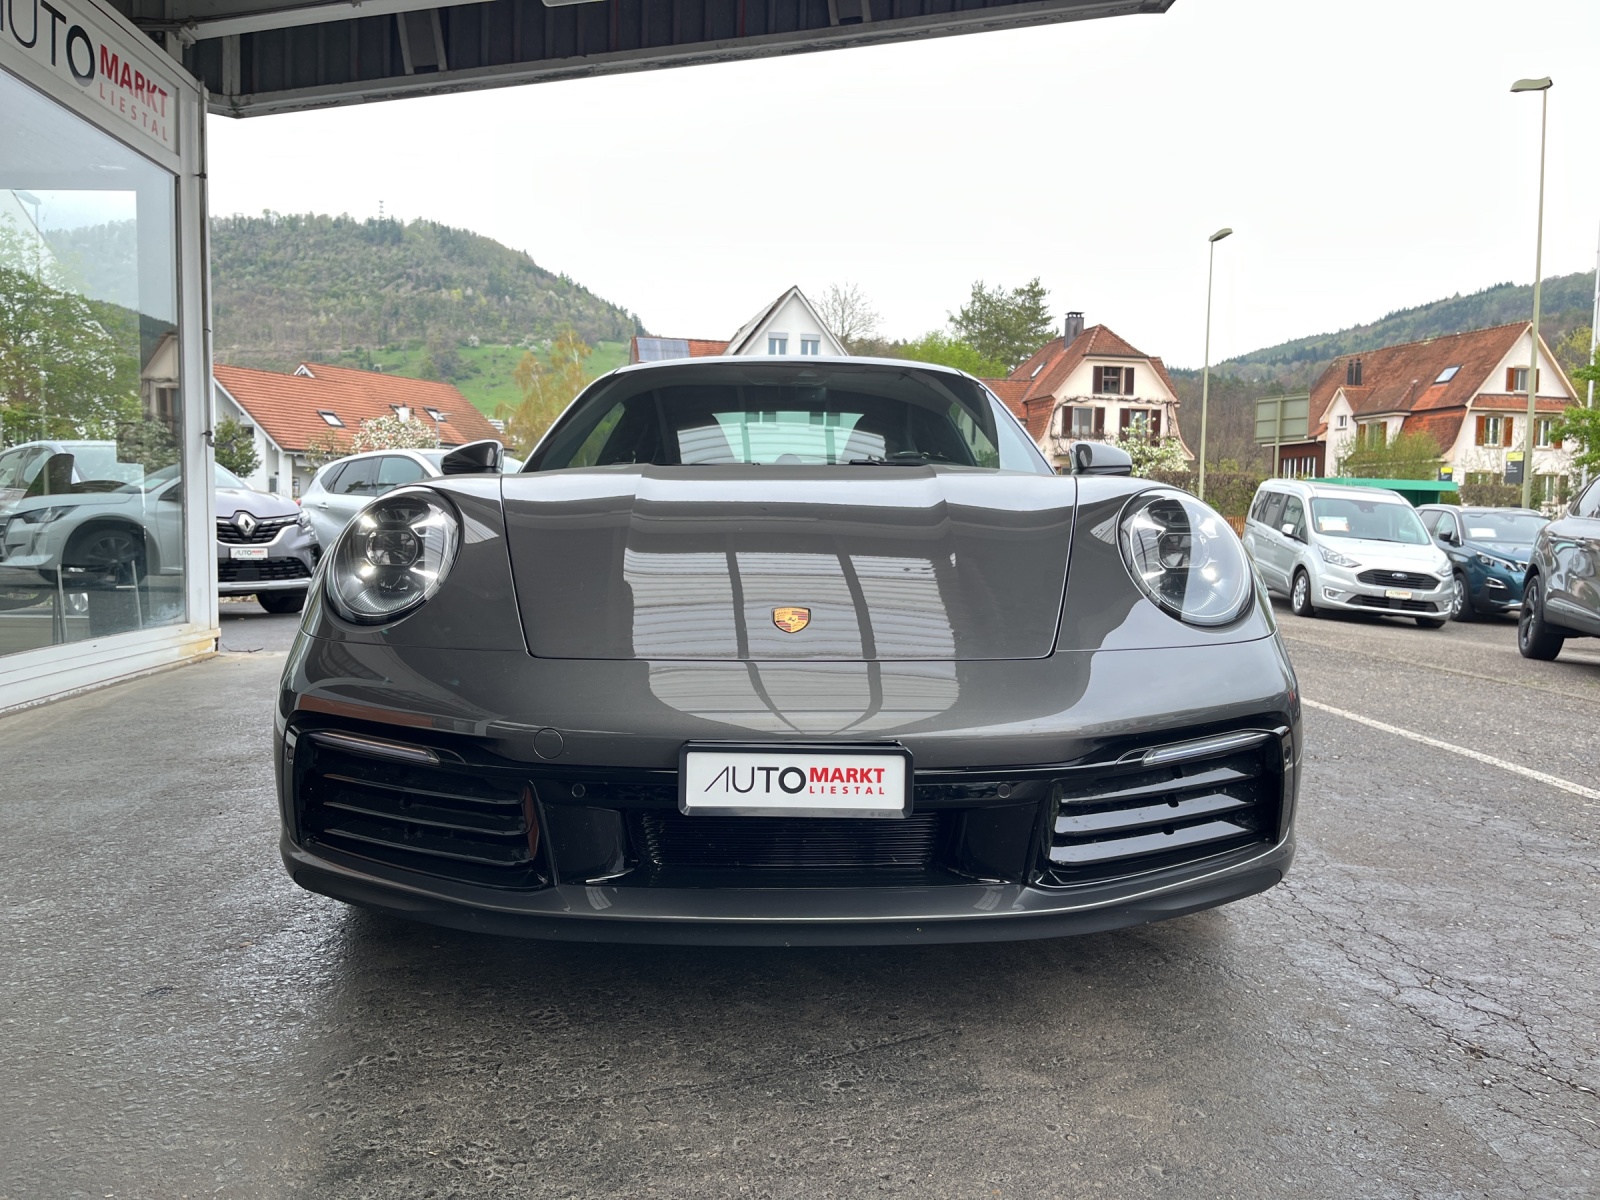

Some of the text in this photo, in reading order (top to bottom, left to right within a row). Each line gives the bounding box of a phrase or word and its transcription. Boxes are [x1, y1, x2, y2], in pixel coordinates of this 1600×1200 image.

[0, 0, 168, 118] UTO MARKT
[100, 82, 168, 141] LIESTAL
[704, 766, 885, 794] AUTO MARKT
[809, 786, 885, 795] LIESTAL
